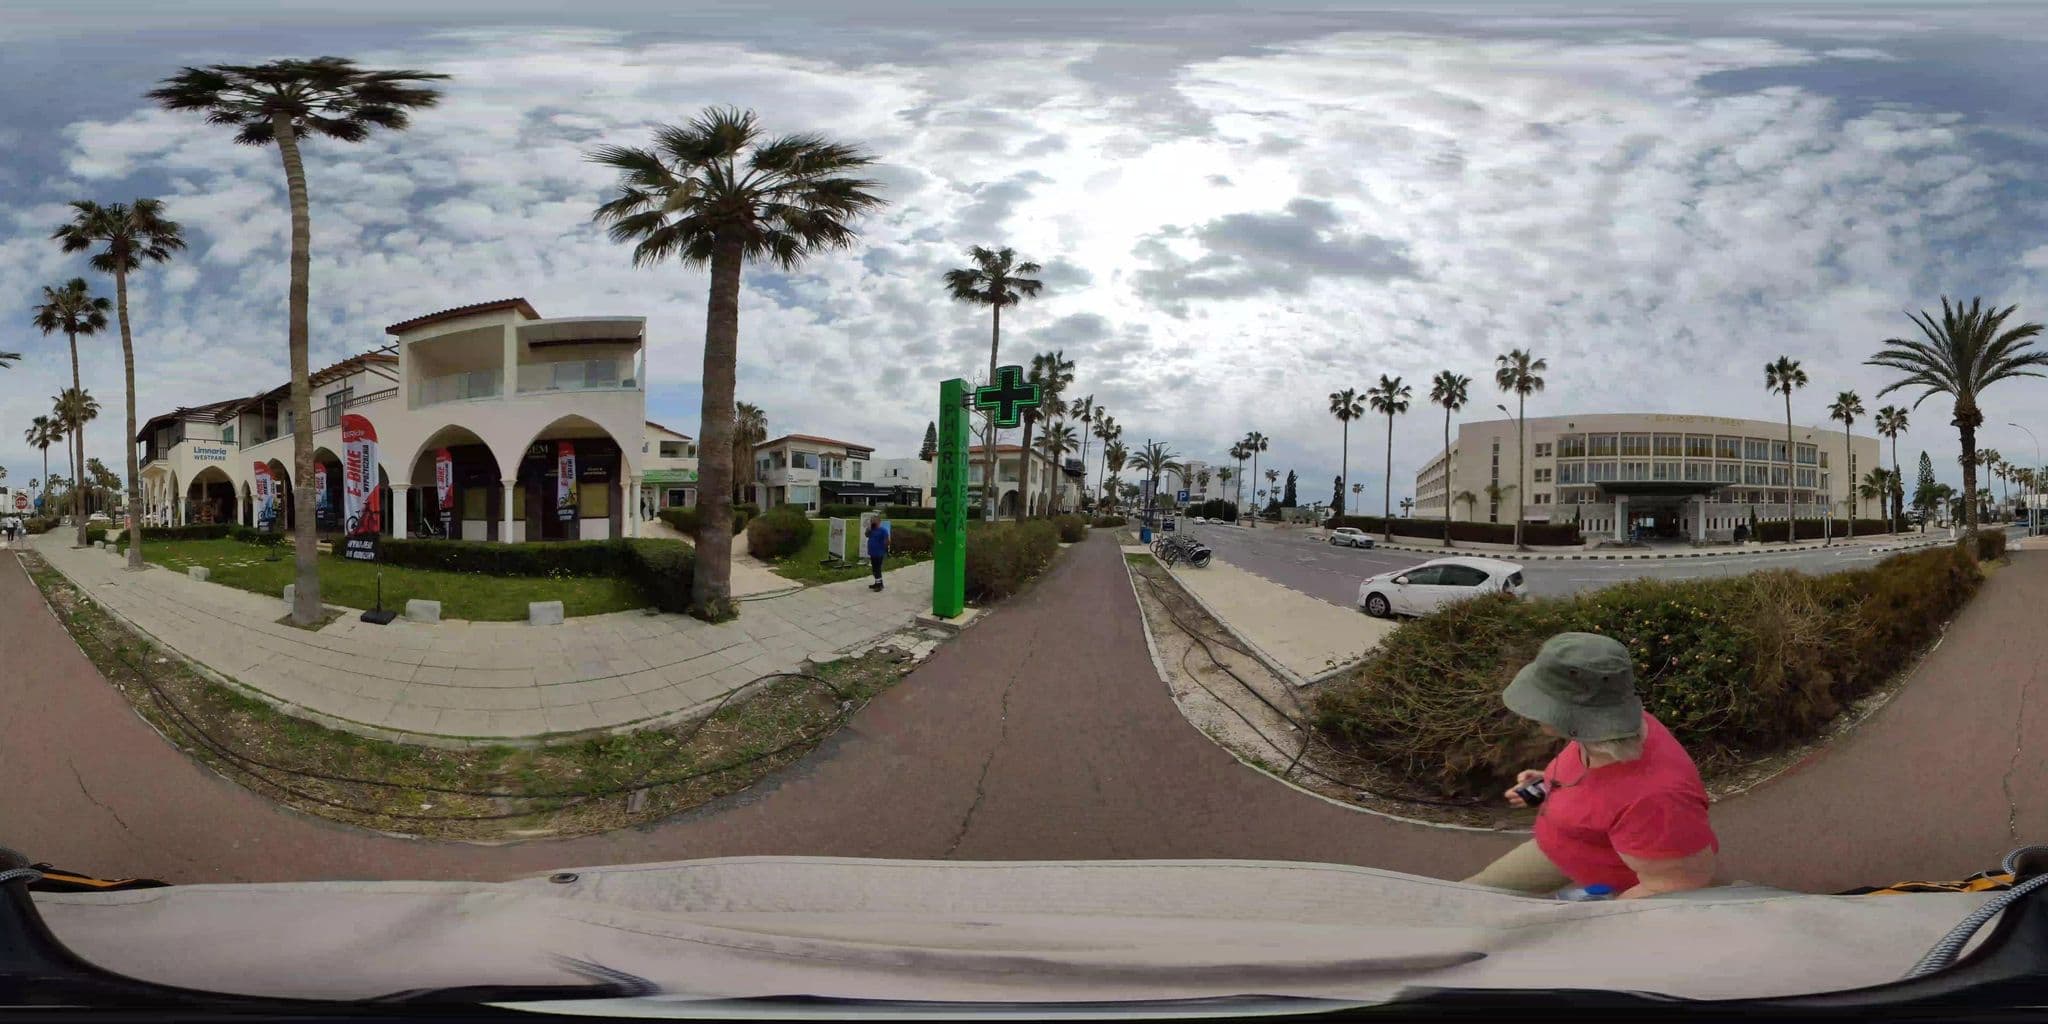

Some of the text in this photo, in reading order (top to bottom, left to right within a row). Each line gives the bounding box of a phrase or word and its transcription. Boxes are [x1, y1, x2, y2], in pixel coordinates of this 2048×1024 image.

[194, 446, 227, 455] Limnaria
[347, 449, 362, 497] E-BIKE
[941, 404, 954, 530] PHARMACY
[1180, 492, 1187, 500] P
